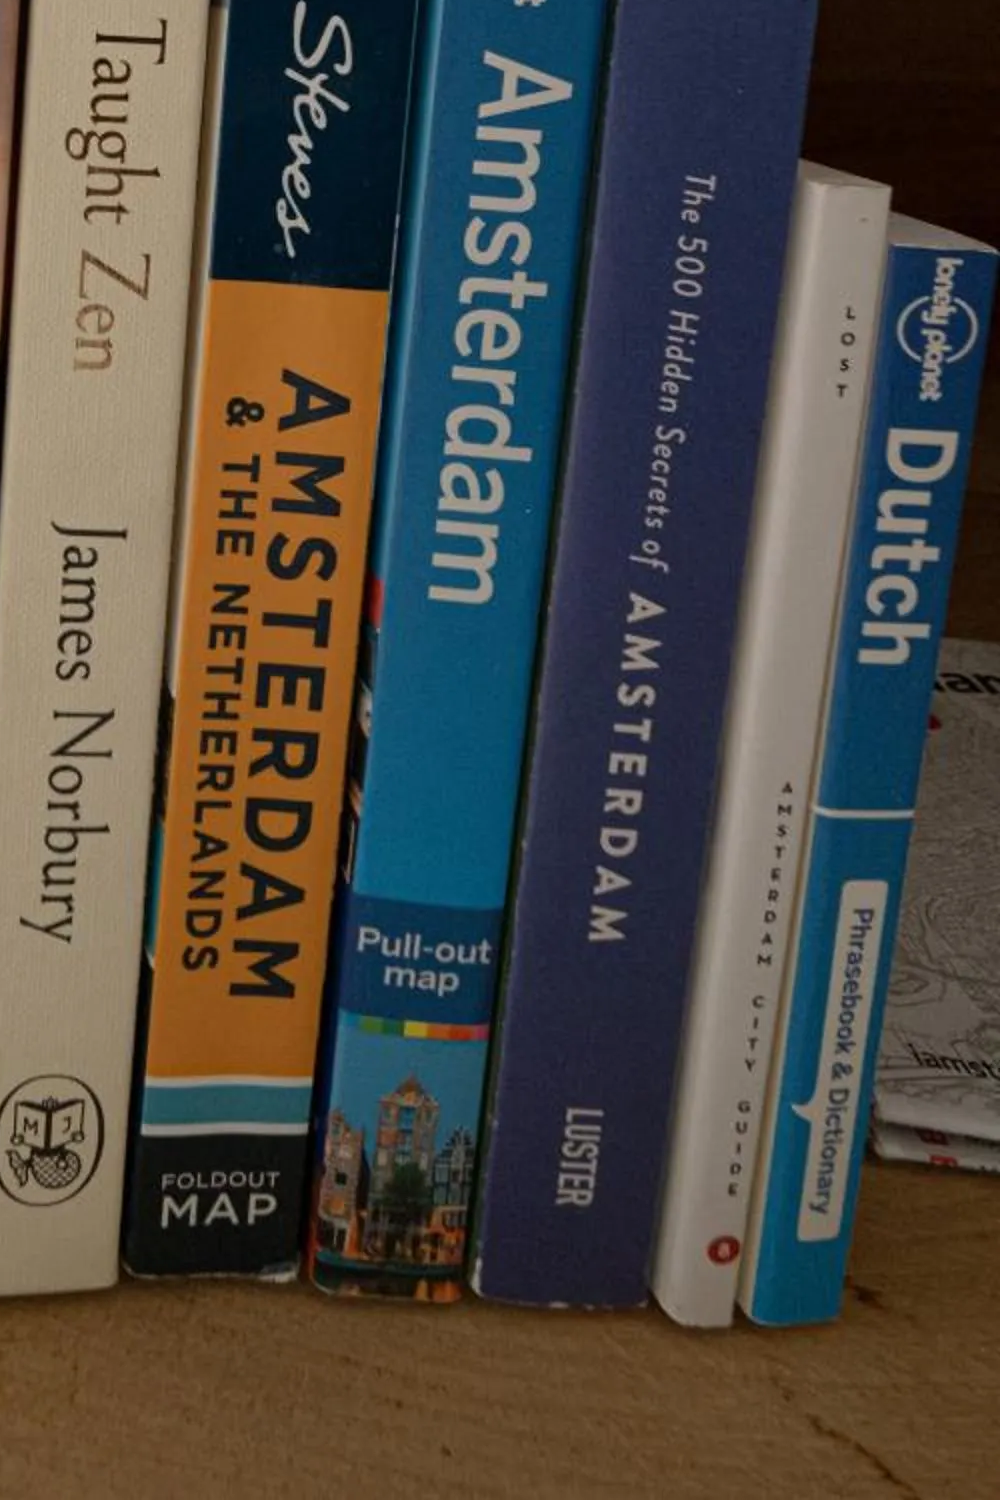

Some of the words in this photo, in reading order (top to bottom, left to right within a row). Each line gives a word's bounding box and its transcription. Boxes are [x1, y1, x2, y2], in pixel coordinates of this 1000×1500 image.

[64, 18, 168, 225] Taught
[275, 0, 354, 259] Steves
[680, 174, 717, 224] The
[72, 249, 151, 373] Zen
[672, 235, 708, 298] 500
[921, 257, 964, 325] lonely
[427, 49, 573, 605] Amsterdam
[658, 308, 700, 413] Hidden
[836, 305, 857, 398] LOST
[919, 326, 953, 402] planet
[225, 396, 265, 428] &
[215, 453, 260, 558] THE
[643, 424, 686, 530] Secrets
[628, 538, 670, 574] of
[857, 427, 960, 666] Dutch
[50, 520, 129, 683] James
[228, 368, 351, 999] AMSTERDAM
[181, 583, 251, 972] NETHERLANDS
[587, 591, 668, 943] AMSTERDAM
[18, 708, 117, 945] Norbury
[756, 781, 794, 966] AMSTERDAM
[355, 926, 491, 965] Pull-out
[383, 965, 460, 997] map
[832, 906, 875, 1055] Phrasebook
[744, 996, 766, 1073] CITY
[831, 1062, 848, 1081] &
[160, 1170, 280, 1191] FOLDOUT
[554, 1107, 605, 1207] LUSTER
[727, 1101, 752, 1197] GUIDE
[809, 1086, 855, 1216] Dictionary
[160, 1195, 279, 1229] MAP
